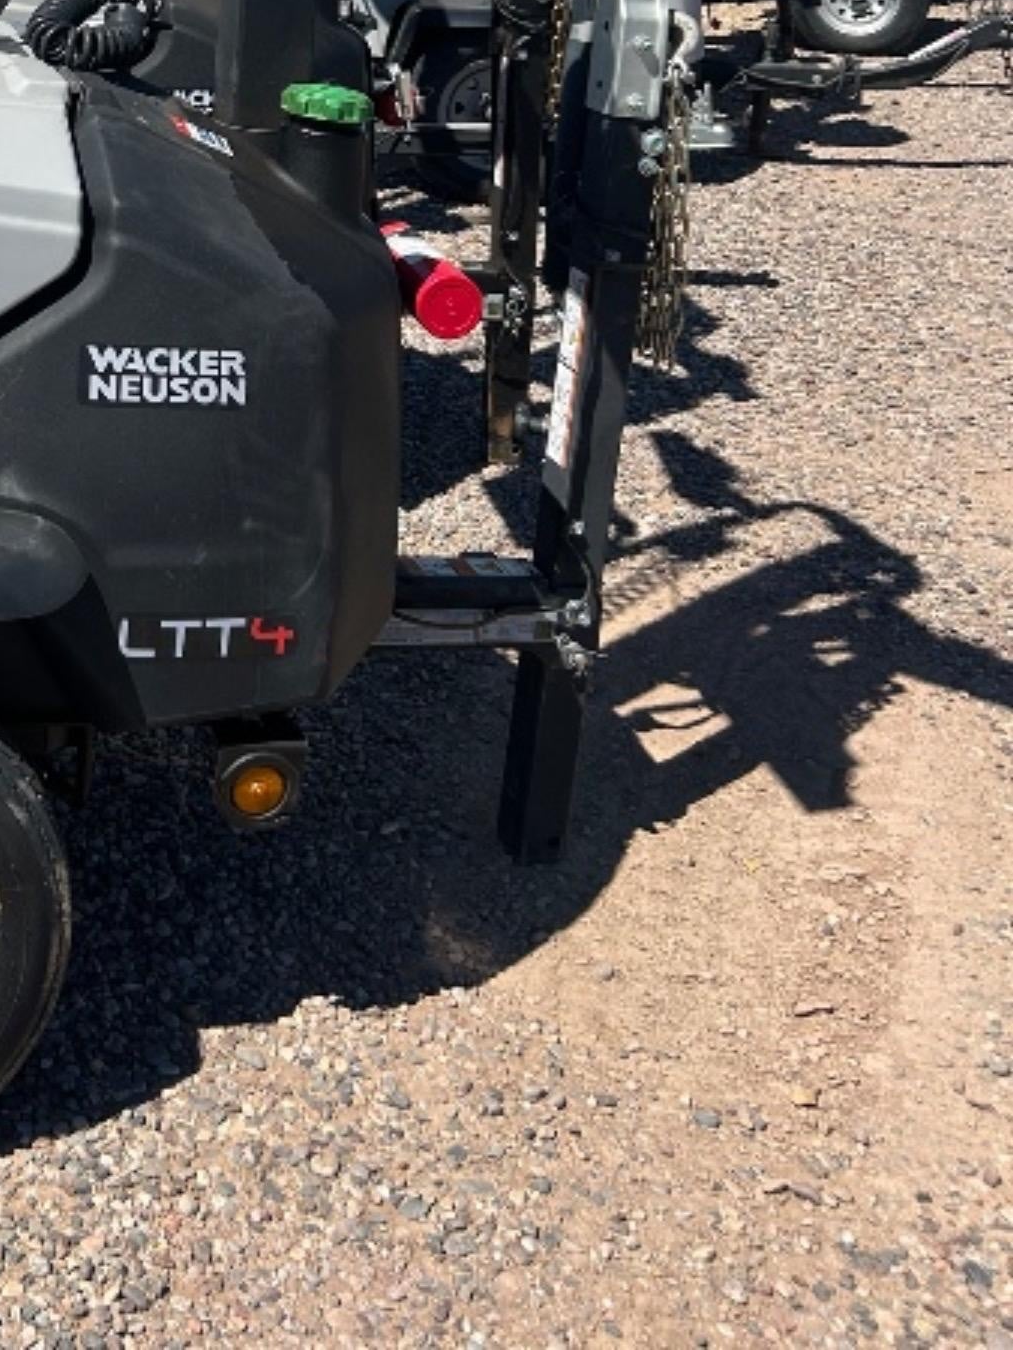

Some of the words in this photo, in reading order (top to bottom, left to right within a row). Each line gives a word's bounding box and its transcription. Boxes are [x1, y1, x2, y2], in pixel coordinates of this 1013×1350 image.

[87, 344, 246, 376] WACKER
[88, 374, 246, 406] NEUSON
[118, 617, 294, 658] LTT4
